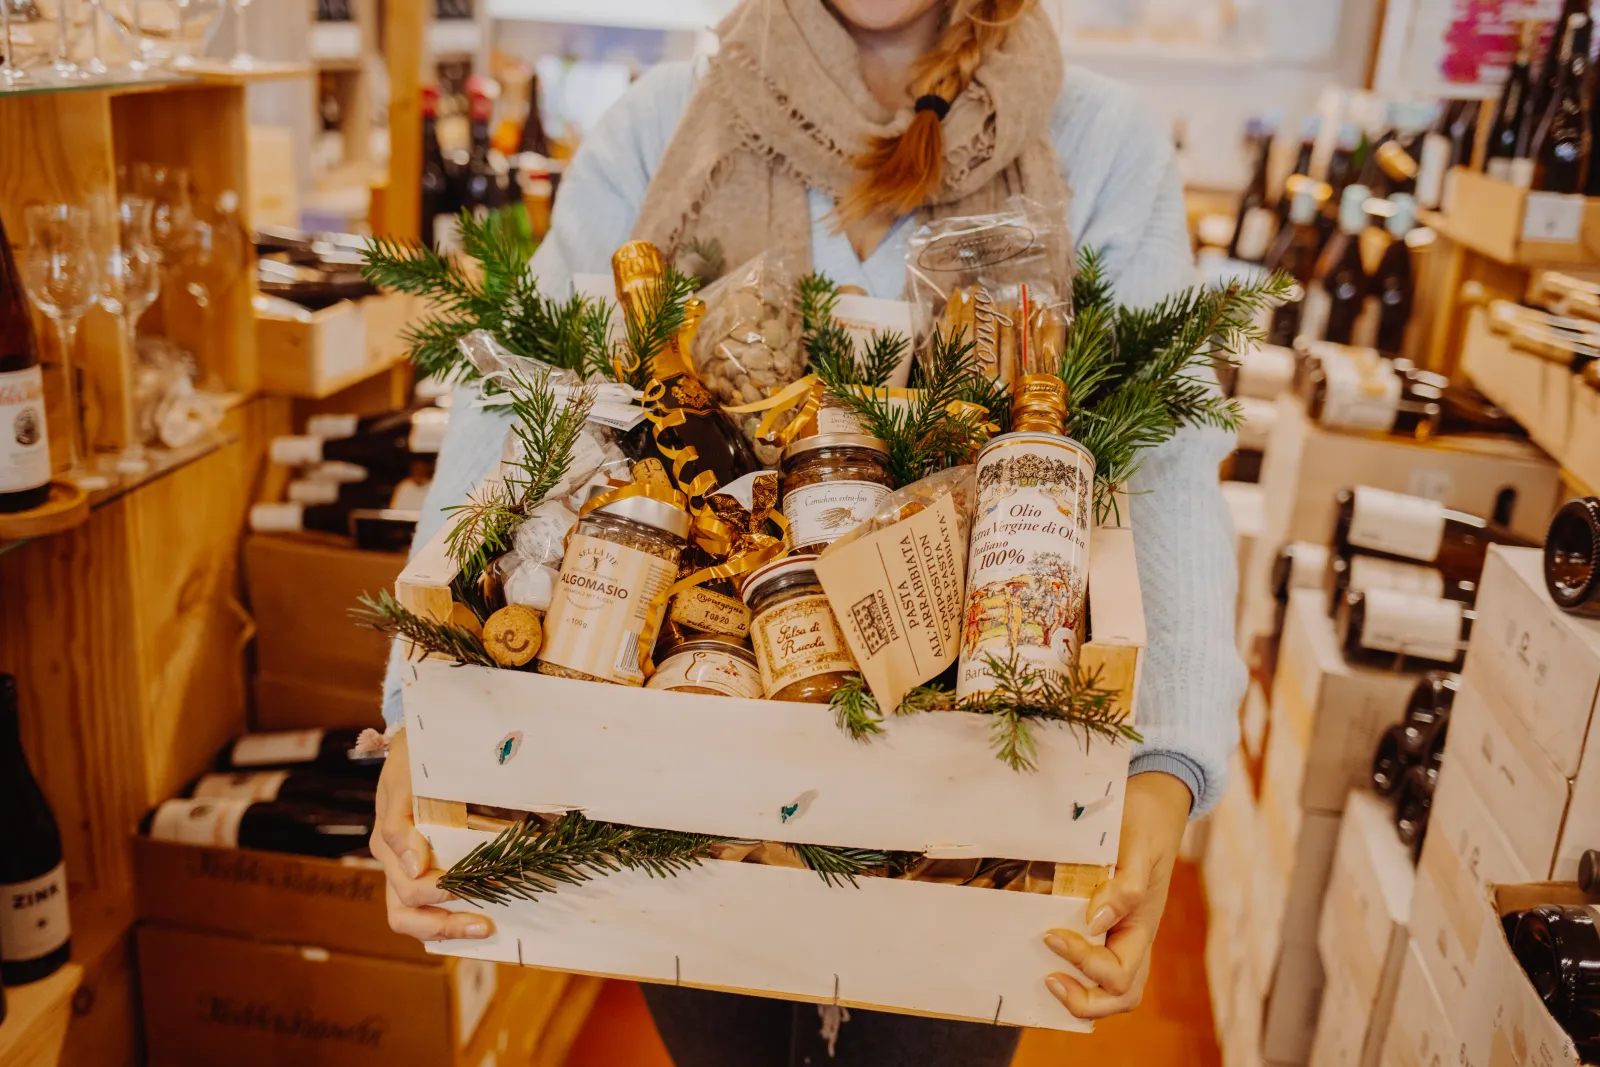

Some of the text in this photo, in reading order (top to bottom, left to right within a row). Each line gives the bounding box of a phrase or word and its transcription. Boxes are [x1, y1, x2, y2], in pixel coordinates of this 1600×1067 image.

[1009, 503, 1042, 518] Olio
[970, 519, 1085, 549] Extra Vergine di Oliva
[605, 552, 619, 568] VIE
[973, 541, 1009, 558] Italiano
[979, 548, 1025, 571] 100%
[560, 572, 628, 600] ALGOMASIO
[919, 534, 952, 641] KOMPOSITION
[934, 542, 956, 621] FÜR PASTA
[897, 580, 920, 630] PASTA
[900, 535, 943, 658] ALL'ARRABBIATA
[571, 617, 583, 627] 100
[876, 589, 900, 641] PARADISO
[777, 621, 821, 644] Salsa di
[780, 636, 826, 660] Rucola
